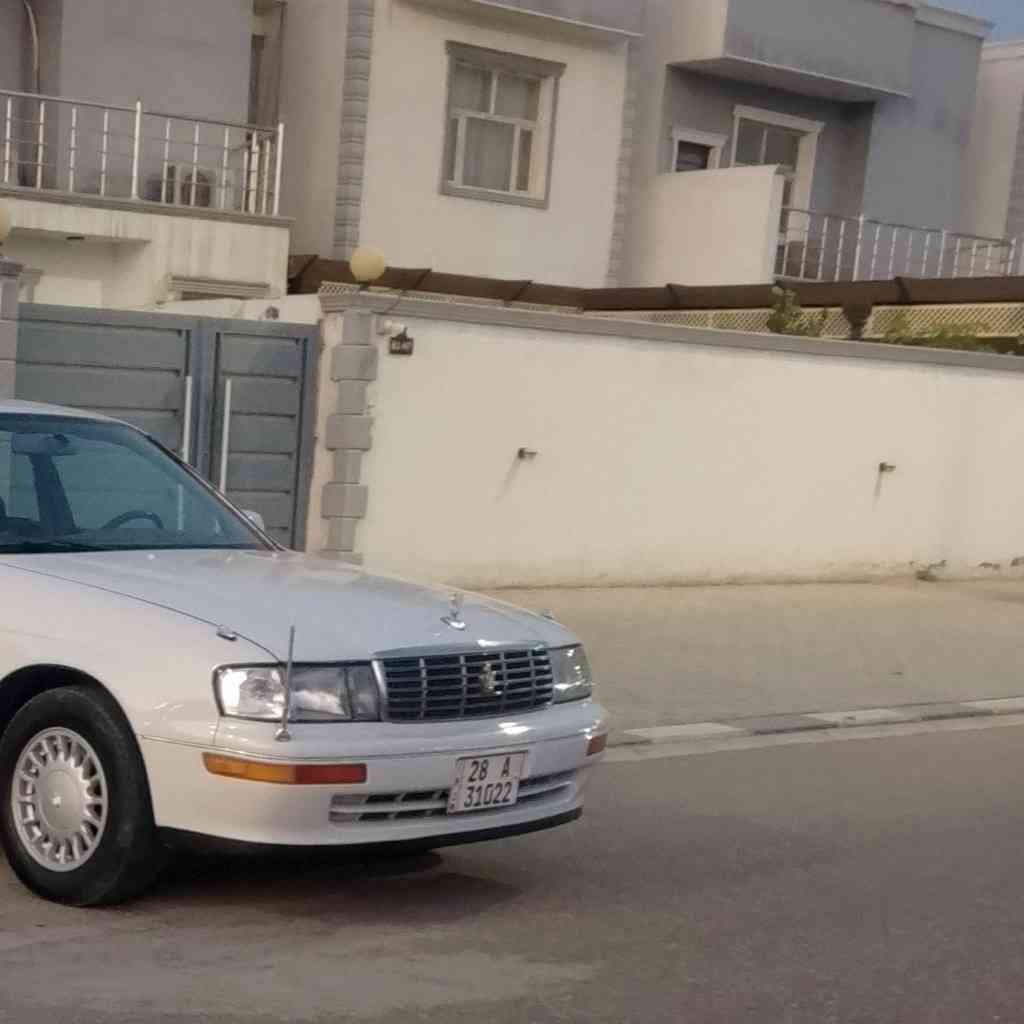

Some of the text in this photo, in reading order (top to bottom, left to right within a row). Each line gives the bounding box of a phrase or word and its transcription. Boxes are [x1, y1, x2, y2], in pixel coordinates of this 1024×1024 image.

[468, 756, 511, 782] 28 A
[464, 781, 512, 807] 31022
